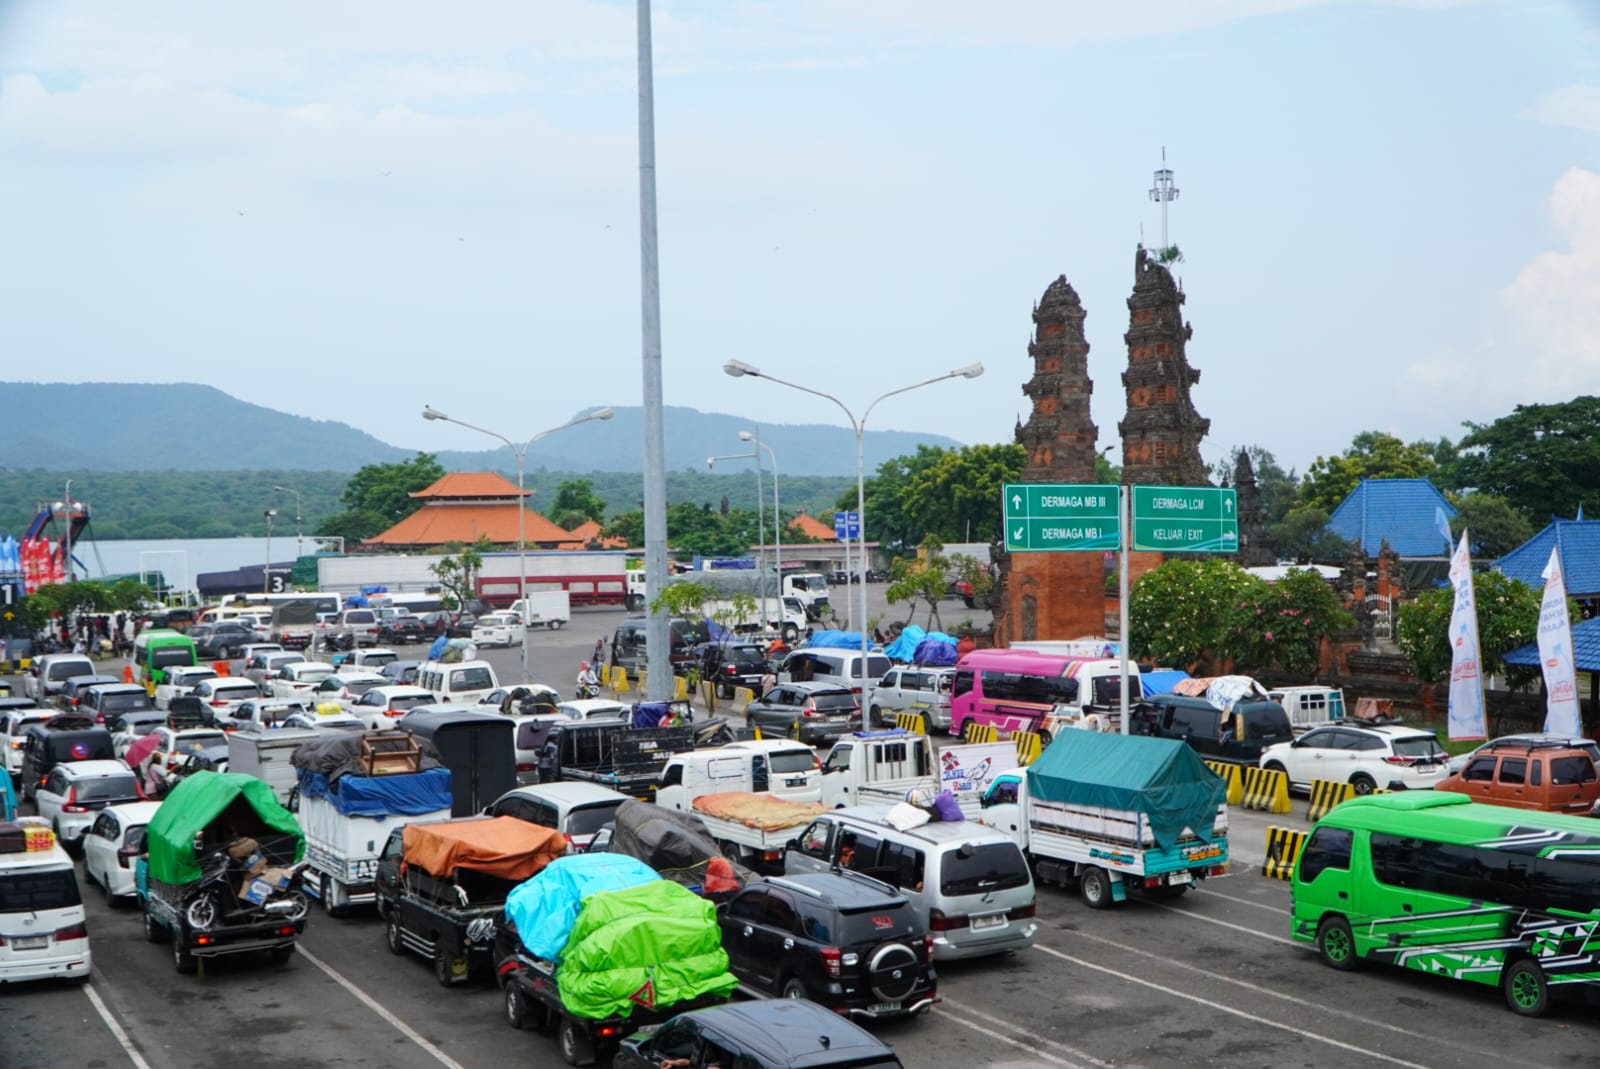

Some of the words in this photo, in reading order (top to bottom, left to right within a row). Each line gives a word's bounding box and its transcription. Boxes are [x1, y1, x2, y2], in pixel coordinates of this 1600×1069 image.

[1041, 496, 1083, 507] DERMAGA
[1084, 496, 1097, 508] MB
[1098, 496, 1106, 507] III
[1152, 497, 1188, 510] DERMAGA
[1188, 498, 1204, 510] LCM
[1042, 528, 1084, 540] DERMAGA
[1085, 528, 1098, 539] MB
[1153, 528, 1183, 540] KELUAR
[1188, 529, 1204, 540] EXIT
[272, 576, 285, 593] 3
[1, 584, 12, 605] 1
